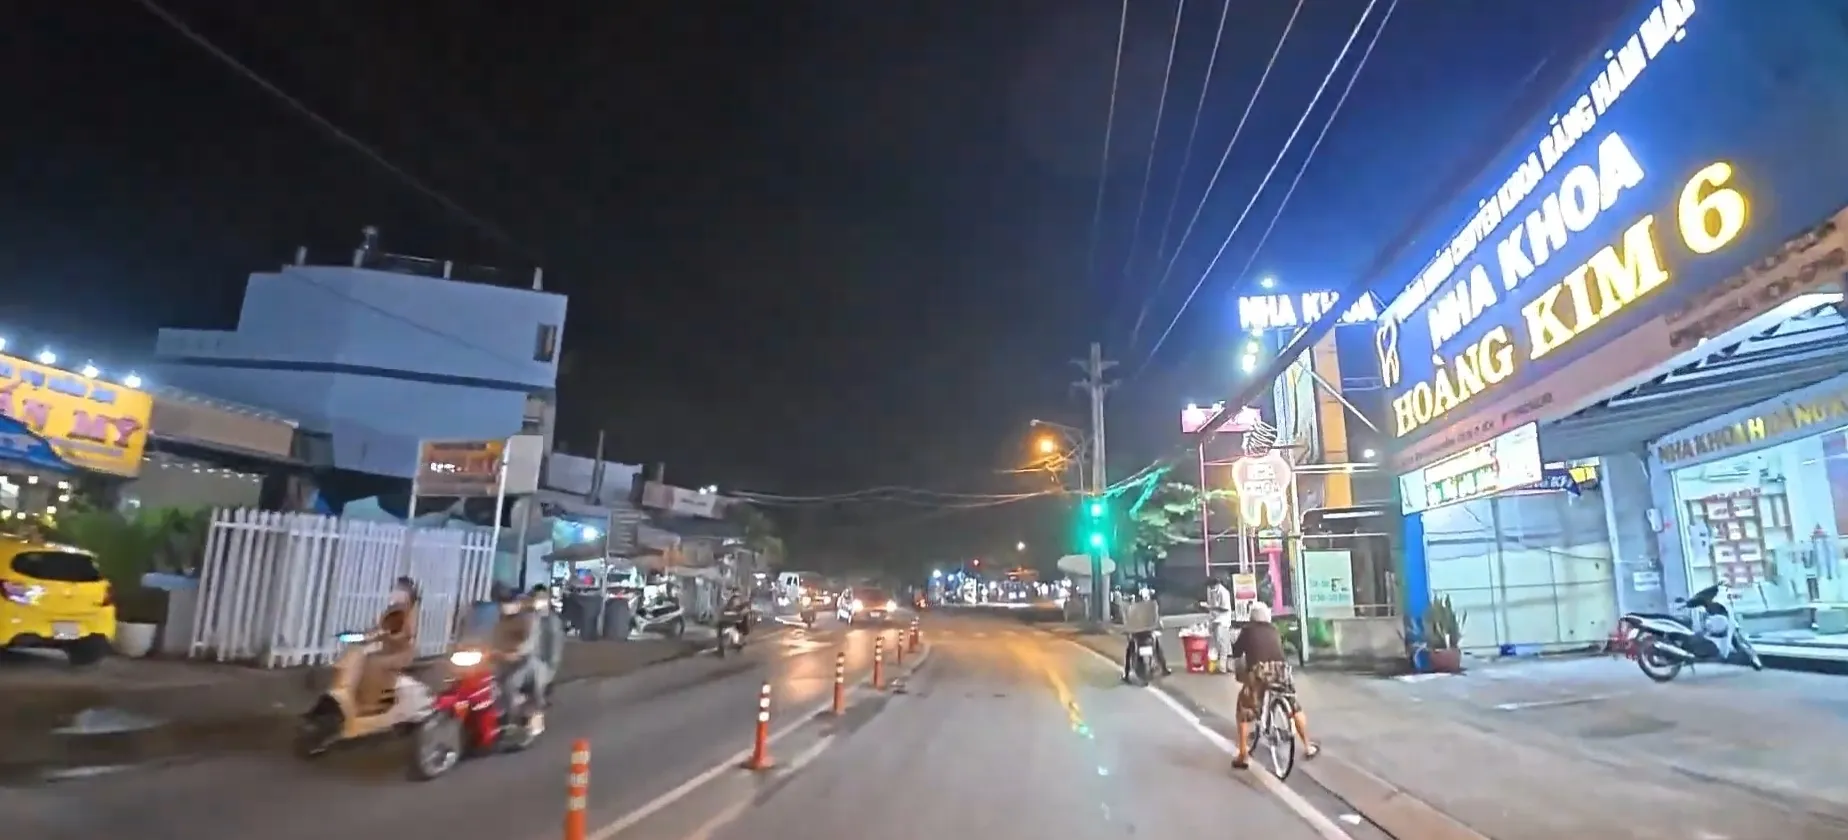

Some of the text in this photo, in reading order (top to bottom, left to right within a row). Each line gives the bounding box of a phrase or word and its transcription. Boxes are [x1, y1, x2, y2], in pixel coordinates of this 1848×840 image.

[1239, 290, 1377, 329] NHA KHA
[1392, 326, 1516, 439] HOÀNG
[1521, 214, 1669, 361] KIM
[1678, 161, 1748, 254] 6
[1427, 264, 1498, 351] NHA
[1497, 131, 1645, 292] KHOA
